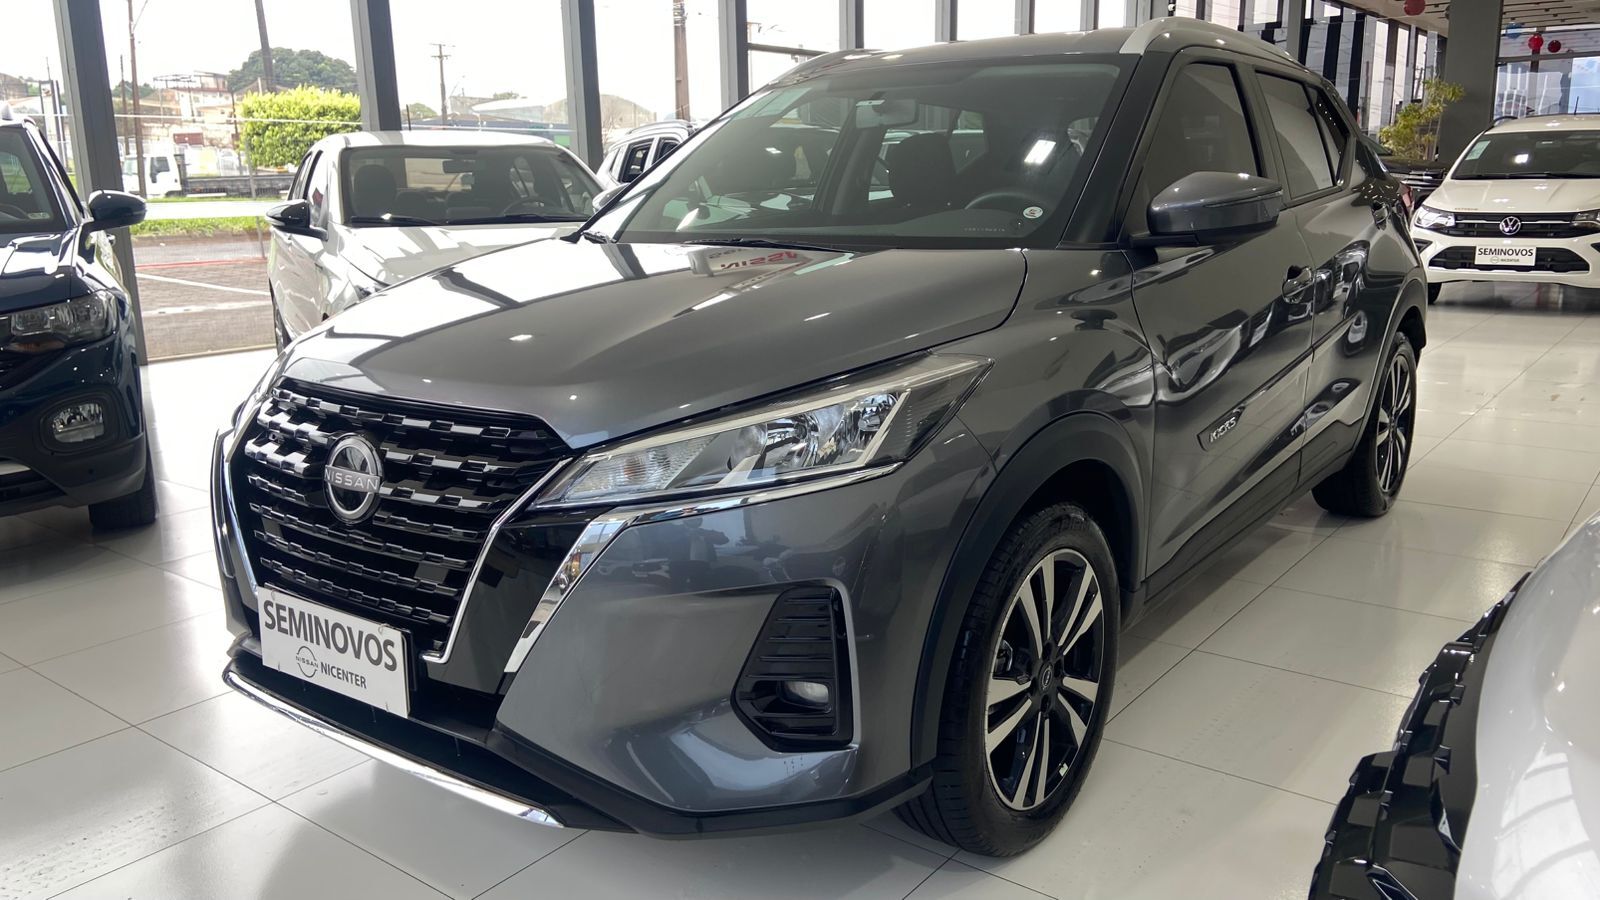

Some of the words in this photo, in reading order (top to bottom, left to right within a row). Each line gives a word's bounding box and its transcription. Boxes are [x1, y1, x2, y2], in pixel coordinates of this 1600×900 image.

[1478, 247, 1534, 256] SEMINOVOS
[324, 467, 378, 490] NISSAN
[263, 600, 397, 672] SEMINOVOS
[296, 655, 319, 669] NISSAN
[320, 662, 367, 689] NICENTER
